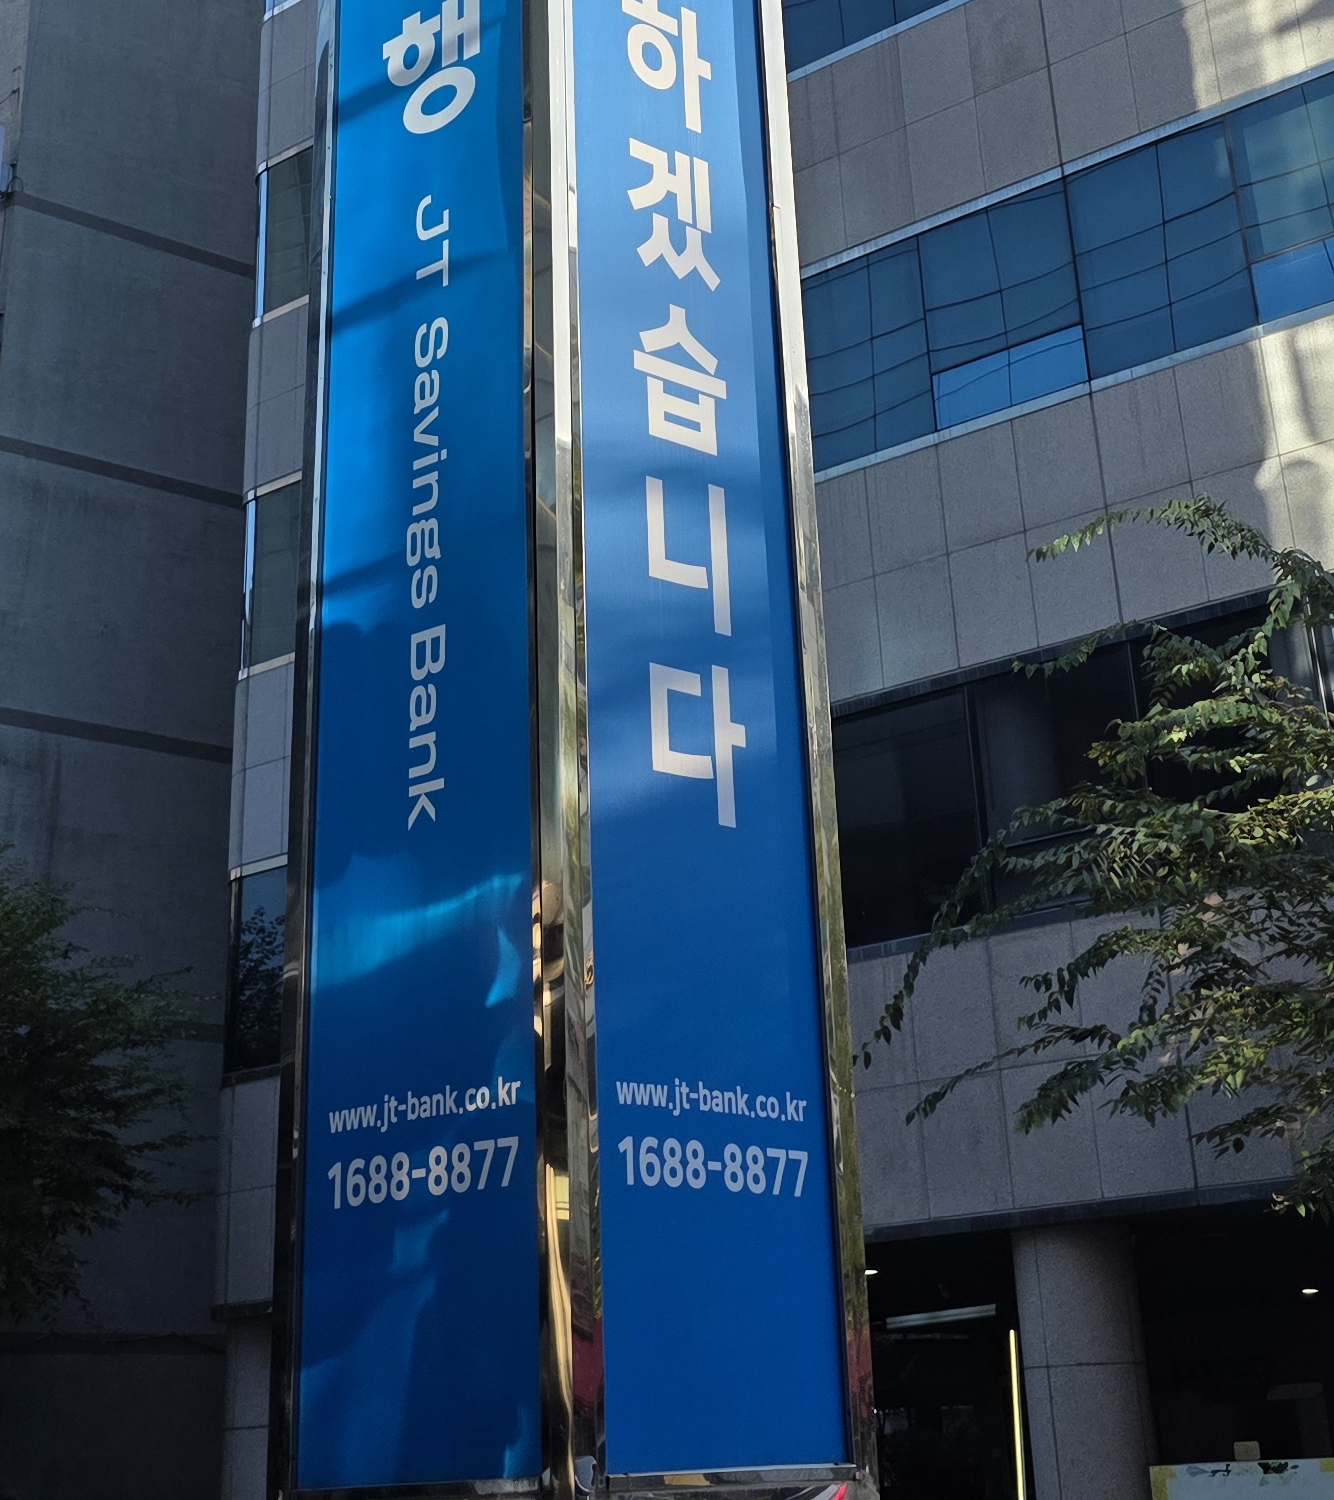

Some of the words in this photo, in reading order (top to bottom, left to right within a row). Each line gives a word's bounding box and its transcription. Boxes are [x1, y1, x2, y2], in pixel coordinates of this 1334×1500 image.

[415, 195, 450, 287] JT
[406, 316, 450, 610] Savings
[407, 623, 446, 831] Bank
[328, 1076, 522, 1135] www.jt-bank.co.kr
[615, 1077, 807, 1123] www.jt-bank.co.kr
[327, 1136, 520, 1210] 1688-8877
[617, 1135, 809, 1198] 1688-8877
